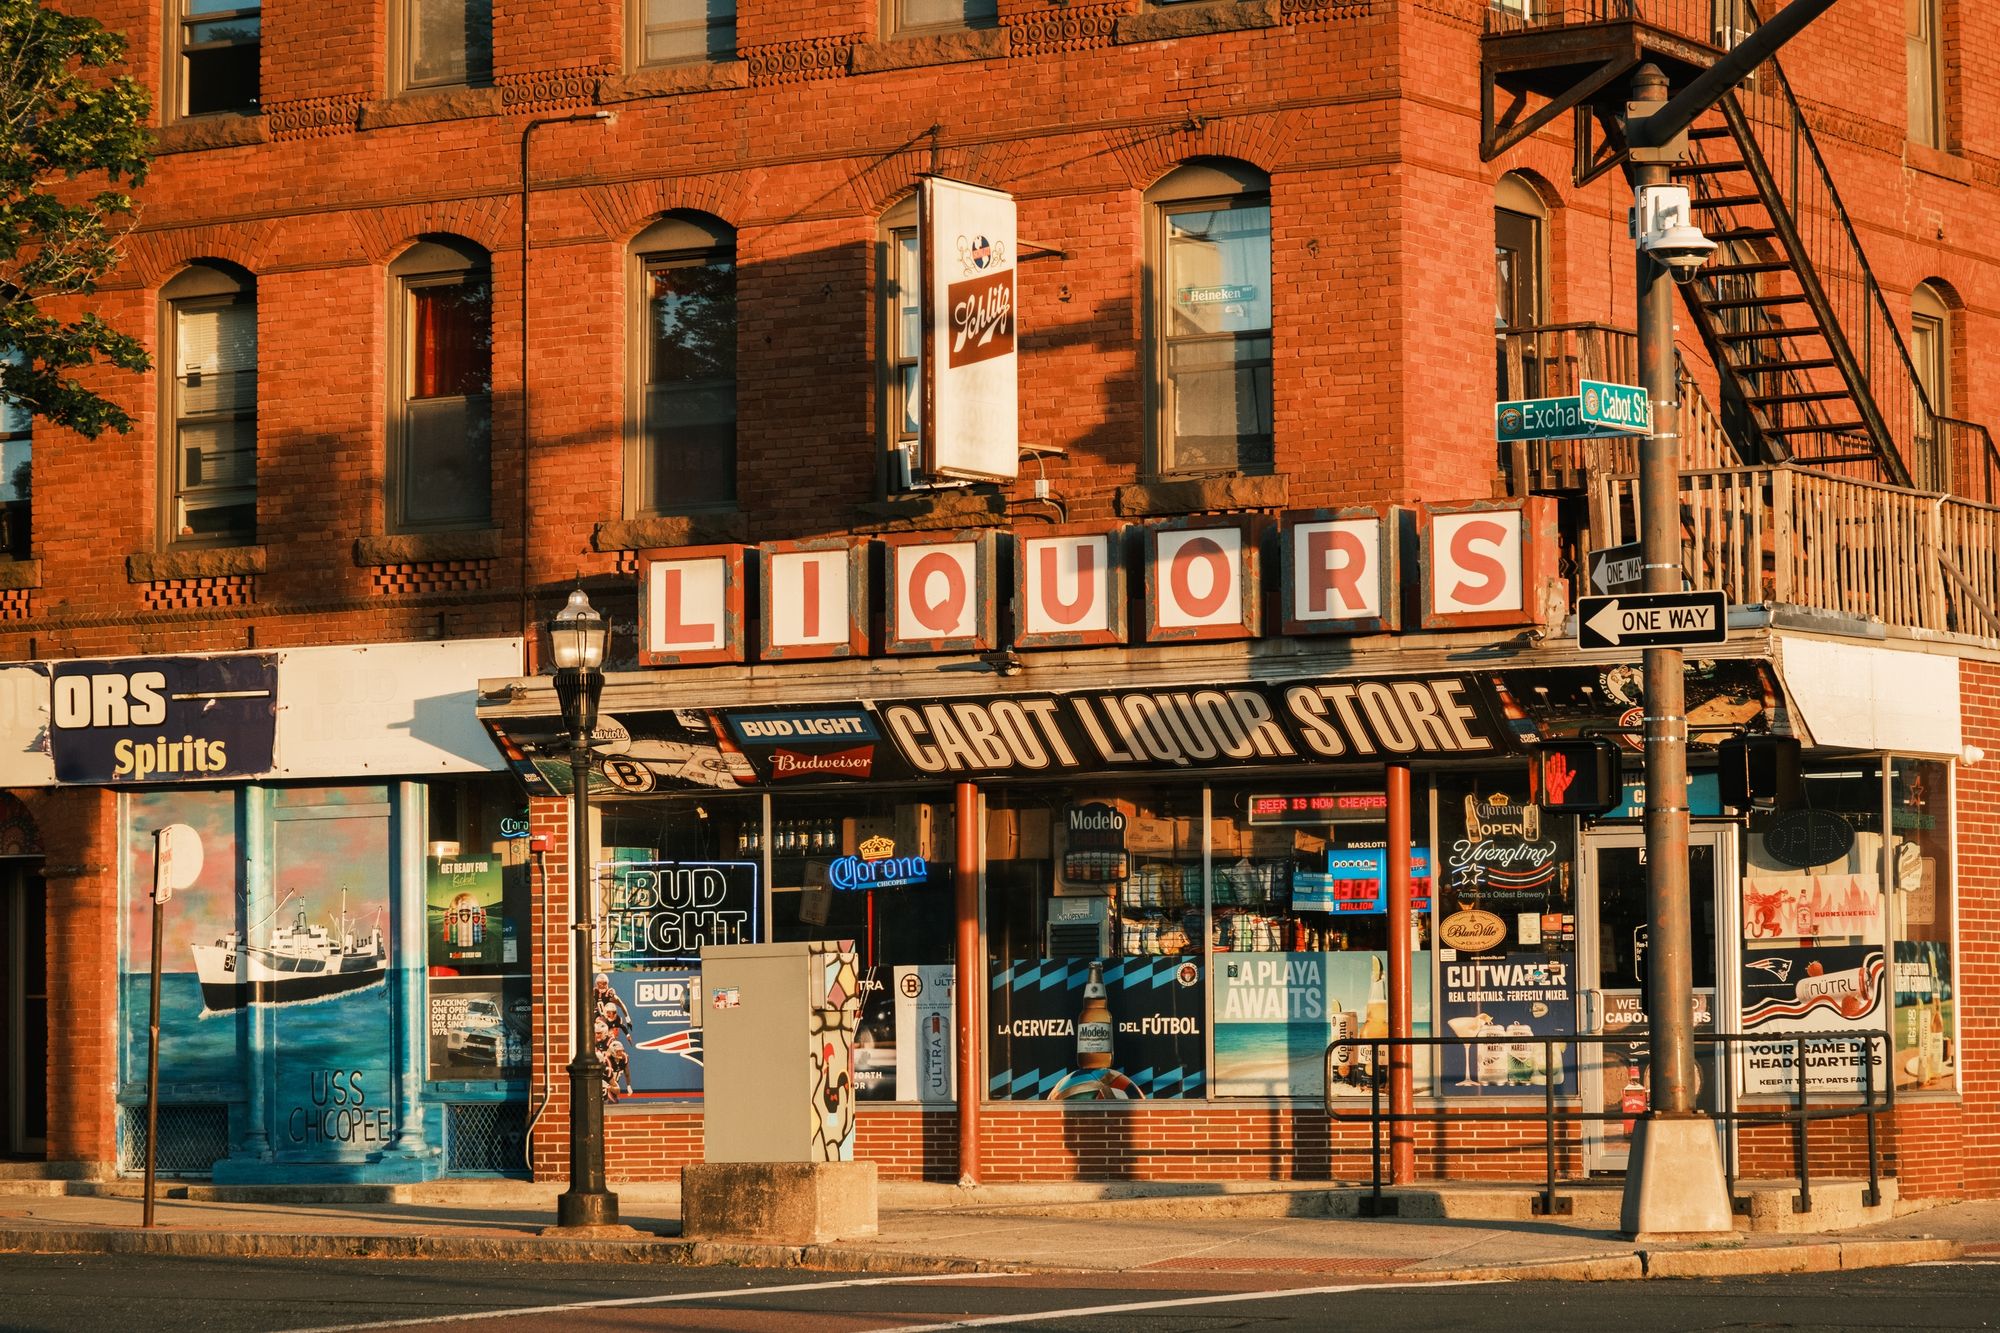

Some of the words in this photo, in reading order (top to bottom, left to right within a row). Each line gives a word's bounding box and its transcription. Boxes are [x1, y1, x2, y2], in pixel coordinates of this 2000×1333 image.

[1191, 288, 1241, 301] Heineken
[954, 283, 1010, 353] Schlitz
[1523, 402, 1596, 430] Exchan
[1601, 387, 1631, 421] Cabot
[1634, 393, 1645, 423] St
[664, 520, 1507, 645] LIQUORS
[1606, 562, 1624, 584] ONE
[1622, 611, 1661, 631] ONE
[1669, 608, 1709, 629] WAY
[54, 671, 166, 729] ORS
[590, 728, 628, 739] atriots
[740, 720, 793, 736] BUD
[792, 717, 862, 735] LIGHT
[885, 696, 1078, 772] CABOT
[1073, 687, 1289, 764] LIQUOR
[1286, 678, 1493, 757] STORE
[113, 734, 227, 781] Spirits
[768, 754, 872, 771] Budweiser
[1260, 800, 1287, 810] BEER
[1293, 799, 1307, 810] IS
[1311, 798, 1334, 809] NOW
[1338, 797, 1387, 808] CHEAPER
[1476, 803, 1523, 819] Corona
[501, 818, 529, 833] Coro
[1070, 810, 1123, 830] Modelo
[1481, 824, 1523, 835] OPEN
[1769, 825, 1848, 852] OPEN
[1449, 840, 1557, 867] Yuengling
[441, 863, 453, 874] GET
[454, 862, 474, 873] READY
[475, 862, 488, 872] FOR
[829, 855, 927, 890] Corona
[626, 869, 726, 909] BUD
[877, 879, 907, 888] CHICOPEE
[1517, 890, 1545, 899] Brewery
[1340, 902, 1373, 910] MILLION
[607, 911, 747, 952] LIGHT
[1447, 922, 1497, 938] BluntVille
[1229, 961, 1254, 985] LA
[1258, 960, 1320, 985] PLAYA
[1447, 964, 1567, 987] CUTWATER
[639, 984, 683, 1001] BUD
[858, 980, 884, 991] TRA
[1448, 991, 1465, 1002] REAL
[1467, 990, 1505, 1002] COCKTAILS.
[1507, 990, 1543, 1001] PERFECTLY
[1545, 989, 1569, 1001] MIXED.
[1224, 987, 1321, 1019] AWAITS
[998, 1025, 1012, 1034] LA
[1013, 1019, 1074, 1036] CERVEZA
[1119, 1022, 1140, 1033] DEL
[1142, 1013, 1199, 1034] FÚTBOL
[1079, 1025, 1110, 1038] Modelo
[1338, 1021, 1348, 1062] Coona
[1360, 1047, 1385, 1057] Corna
[1750, 1044, 1793, 1056] YOUR
[932, 1038, 941, 1087] ULTRA
[289, 1107, 390, 1143] CHICOPEE
